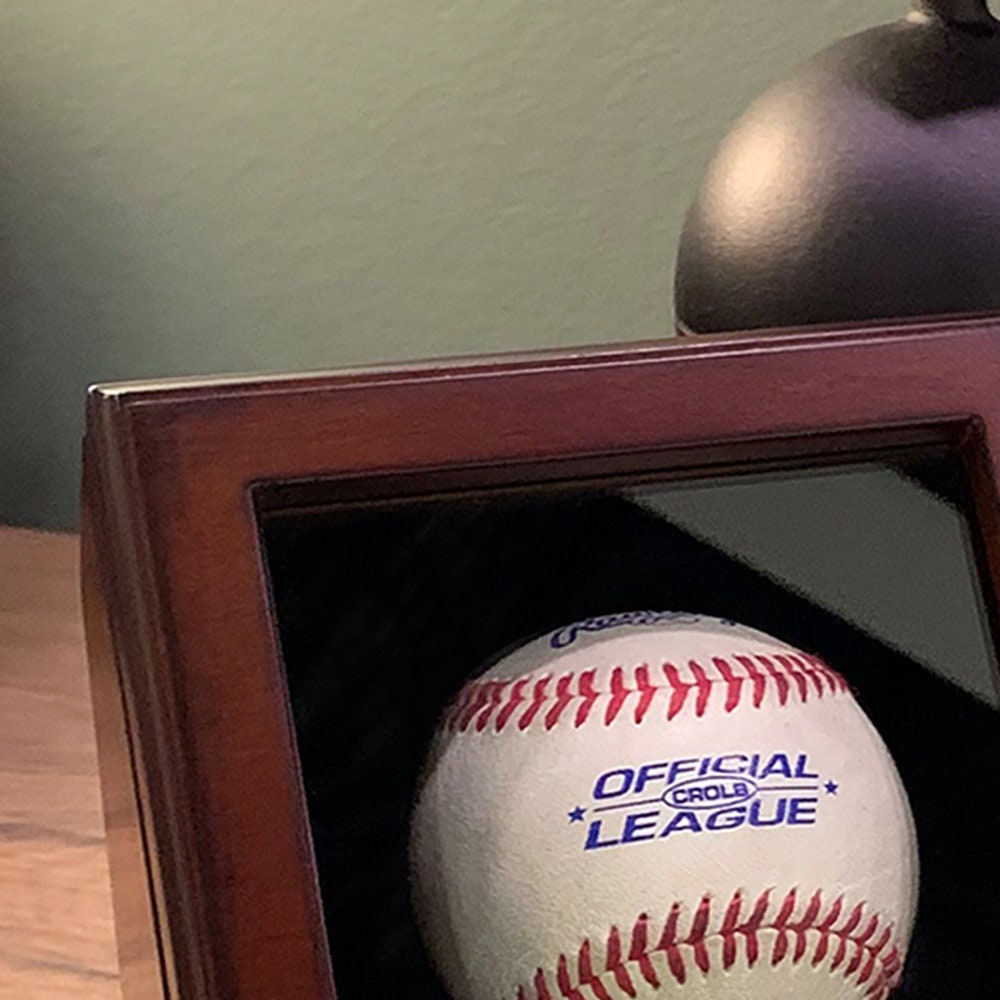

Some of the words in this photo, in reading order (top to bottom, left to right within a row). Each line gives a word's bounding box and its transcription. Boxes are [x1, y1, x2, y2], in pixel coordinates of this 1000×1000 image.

[593, 754, 819, 800] OFFICIAL
[672, 783, 749, 805] CROLB
[584, 798, 818, 850] LEAGUE
